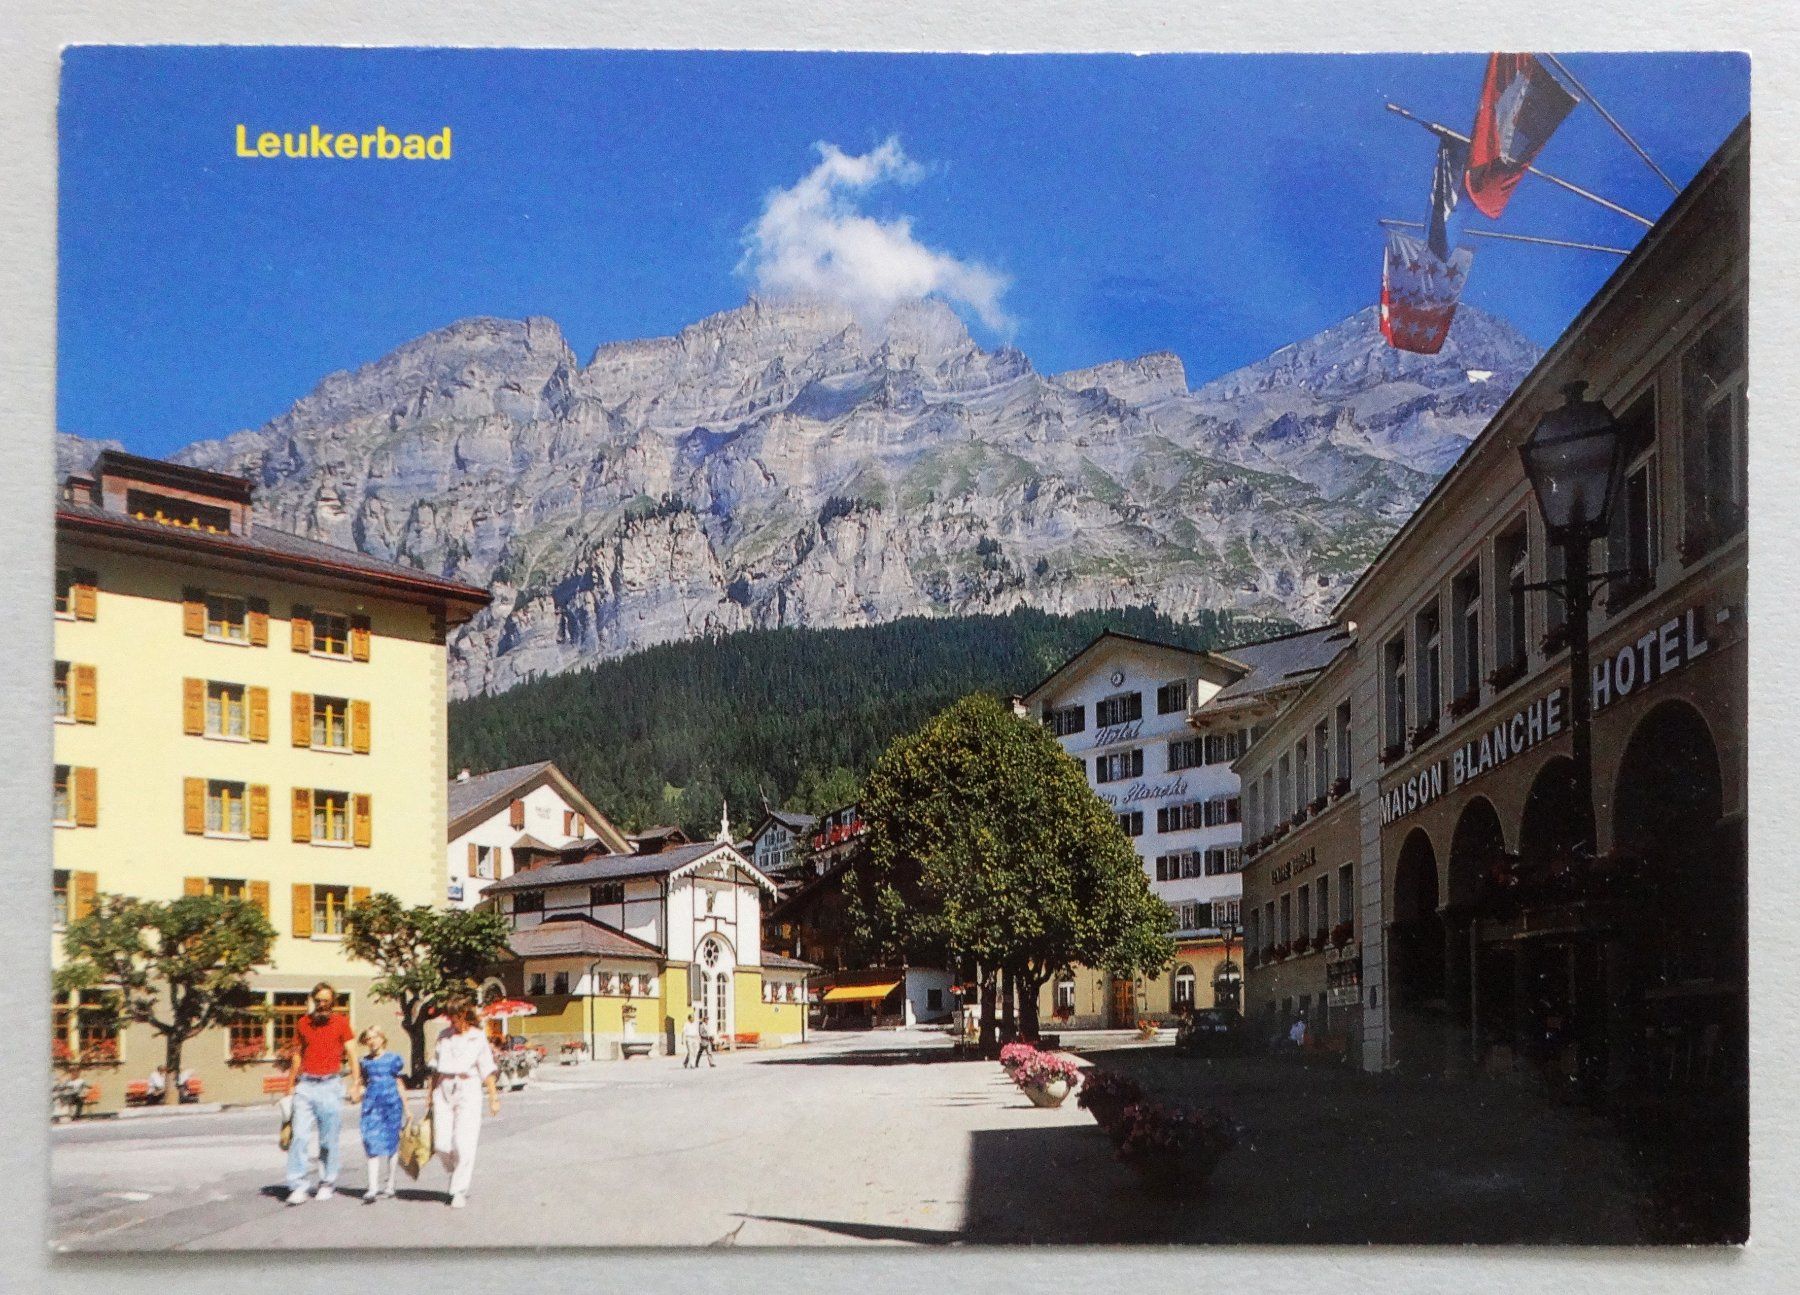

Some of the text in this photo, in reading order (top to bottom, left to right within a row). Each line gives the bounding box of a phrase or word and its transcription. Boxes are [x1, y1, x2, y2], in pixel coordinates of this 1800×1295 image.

[1380, 762, 1442, 826] MAISON
[1453, 688, 1562, 786] BLANCHE
[1593, 607, 1708, 711] HOTEL
